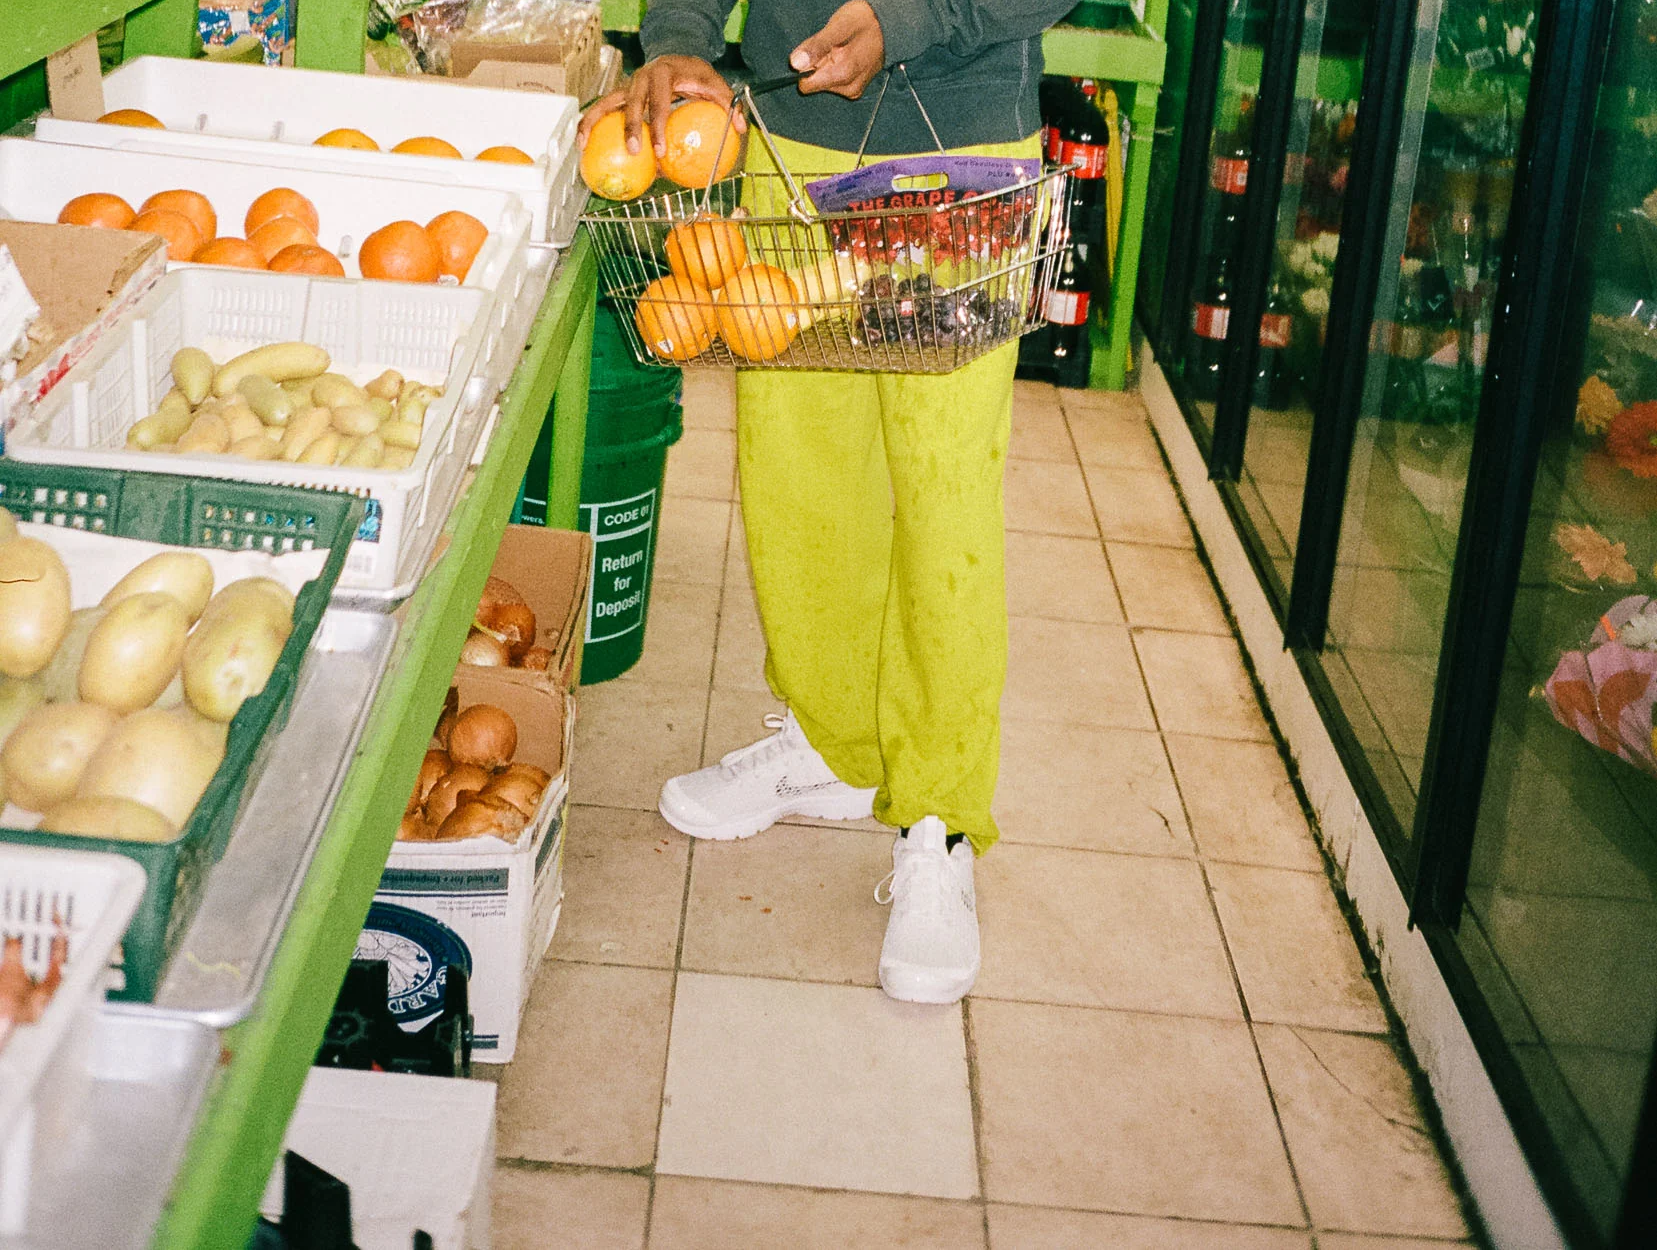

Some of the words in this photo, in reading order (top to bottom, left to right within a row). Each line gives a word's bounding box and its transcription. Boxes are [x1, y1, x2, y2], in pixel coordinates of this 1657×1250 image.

[848, 197, 885, 212] THE
[890, 189, 956, 210] GRAPE
[604, 509, 639, 526] CODE
[602, 550, 643, 573] Return
[614, 576, 632, 592] for
[596, 591, 641, 618] Deposit
[467, 874, 500, 884] Packed
